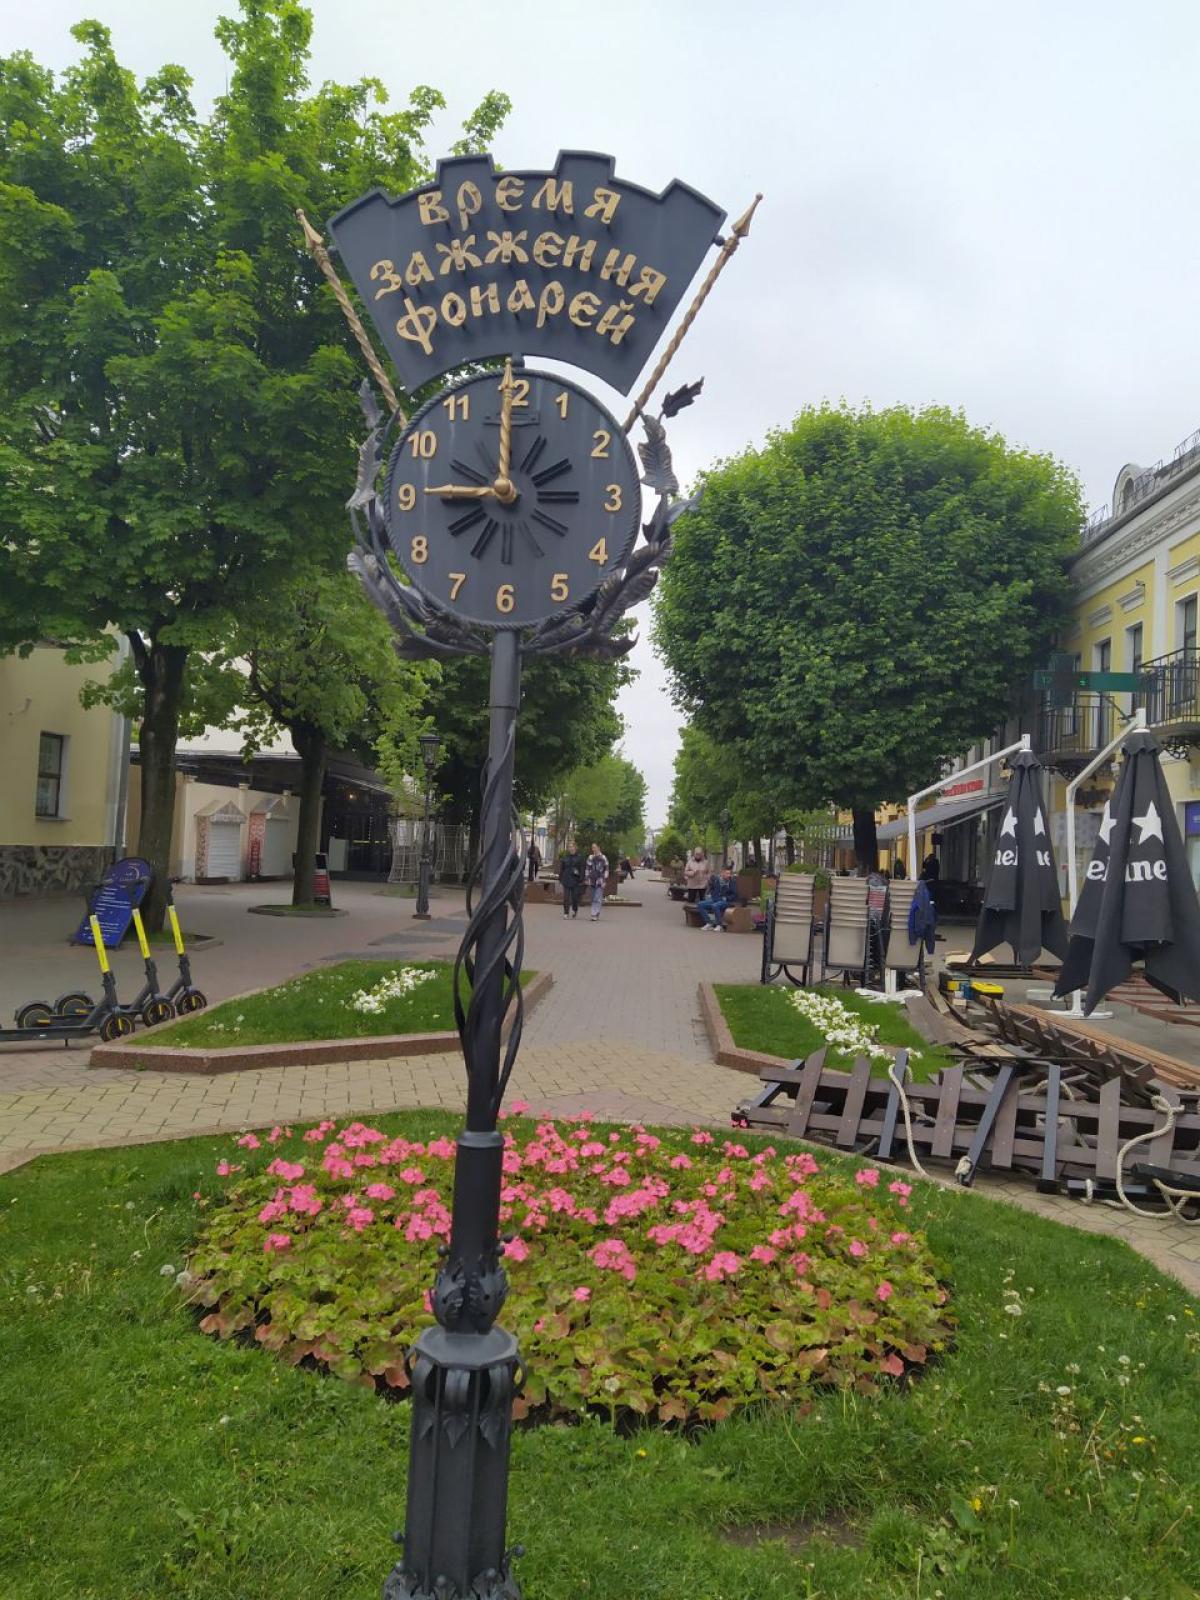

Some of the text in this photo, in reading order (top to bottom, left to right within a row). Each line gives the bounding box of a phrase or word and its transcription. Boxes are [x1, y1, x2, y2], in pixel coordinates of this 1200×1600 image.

[417, 176, 621, 231] ВРЕМЯ
[369, 230, 667, 305] ЗАЖЖЕНИЯ
[396, 279, 635, 354] ФОНАРЕЙ
[443, 394, 470, 421] 11
[555, 392, 569, 419] 1
[408, 430, 437, 458] 10
[591, 429, 611, 458] 2
[398, 483, 416, 511] 9
[604, 484, 623, 512] 3
[410, 535, 428, 564] 8
[588, 537, 609, 565] 4
[448, 573, 466, 601] 7
[496, 584, 515, 612] 6
[551, 573, 569, 601] 5
